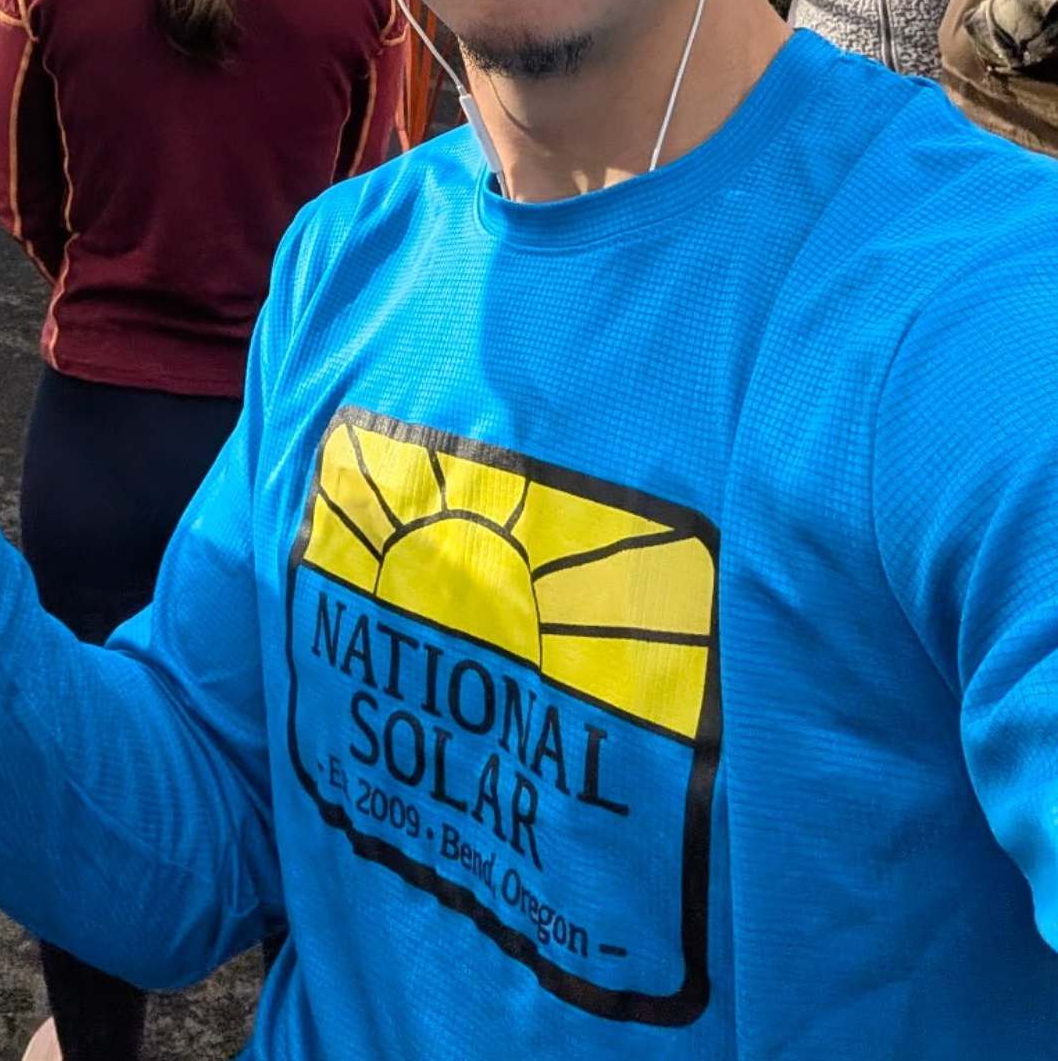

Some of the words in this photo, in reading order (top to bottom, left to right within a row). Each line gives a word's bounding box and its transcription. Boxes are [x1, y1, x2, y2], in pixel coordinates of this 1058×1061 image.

[312, 590, 631, 816] NATIONAL
[349, 690, 542, 871] SOLAR
[356, 778, 421, 838] 2009
[500, 868, 589, 958] Oregon
